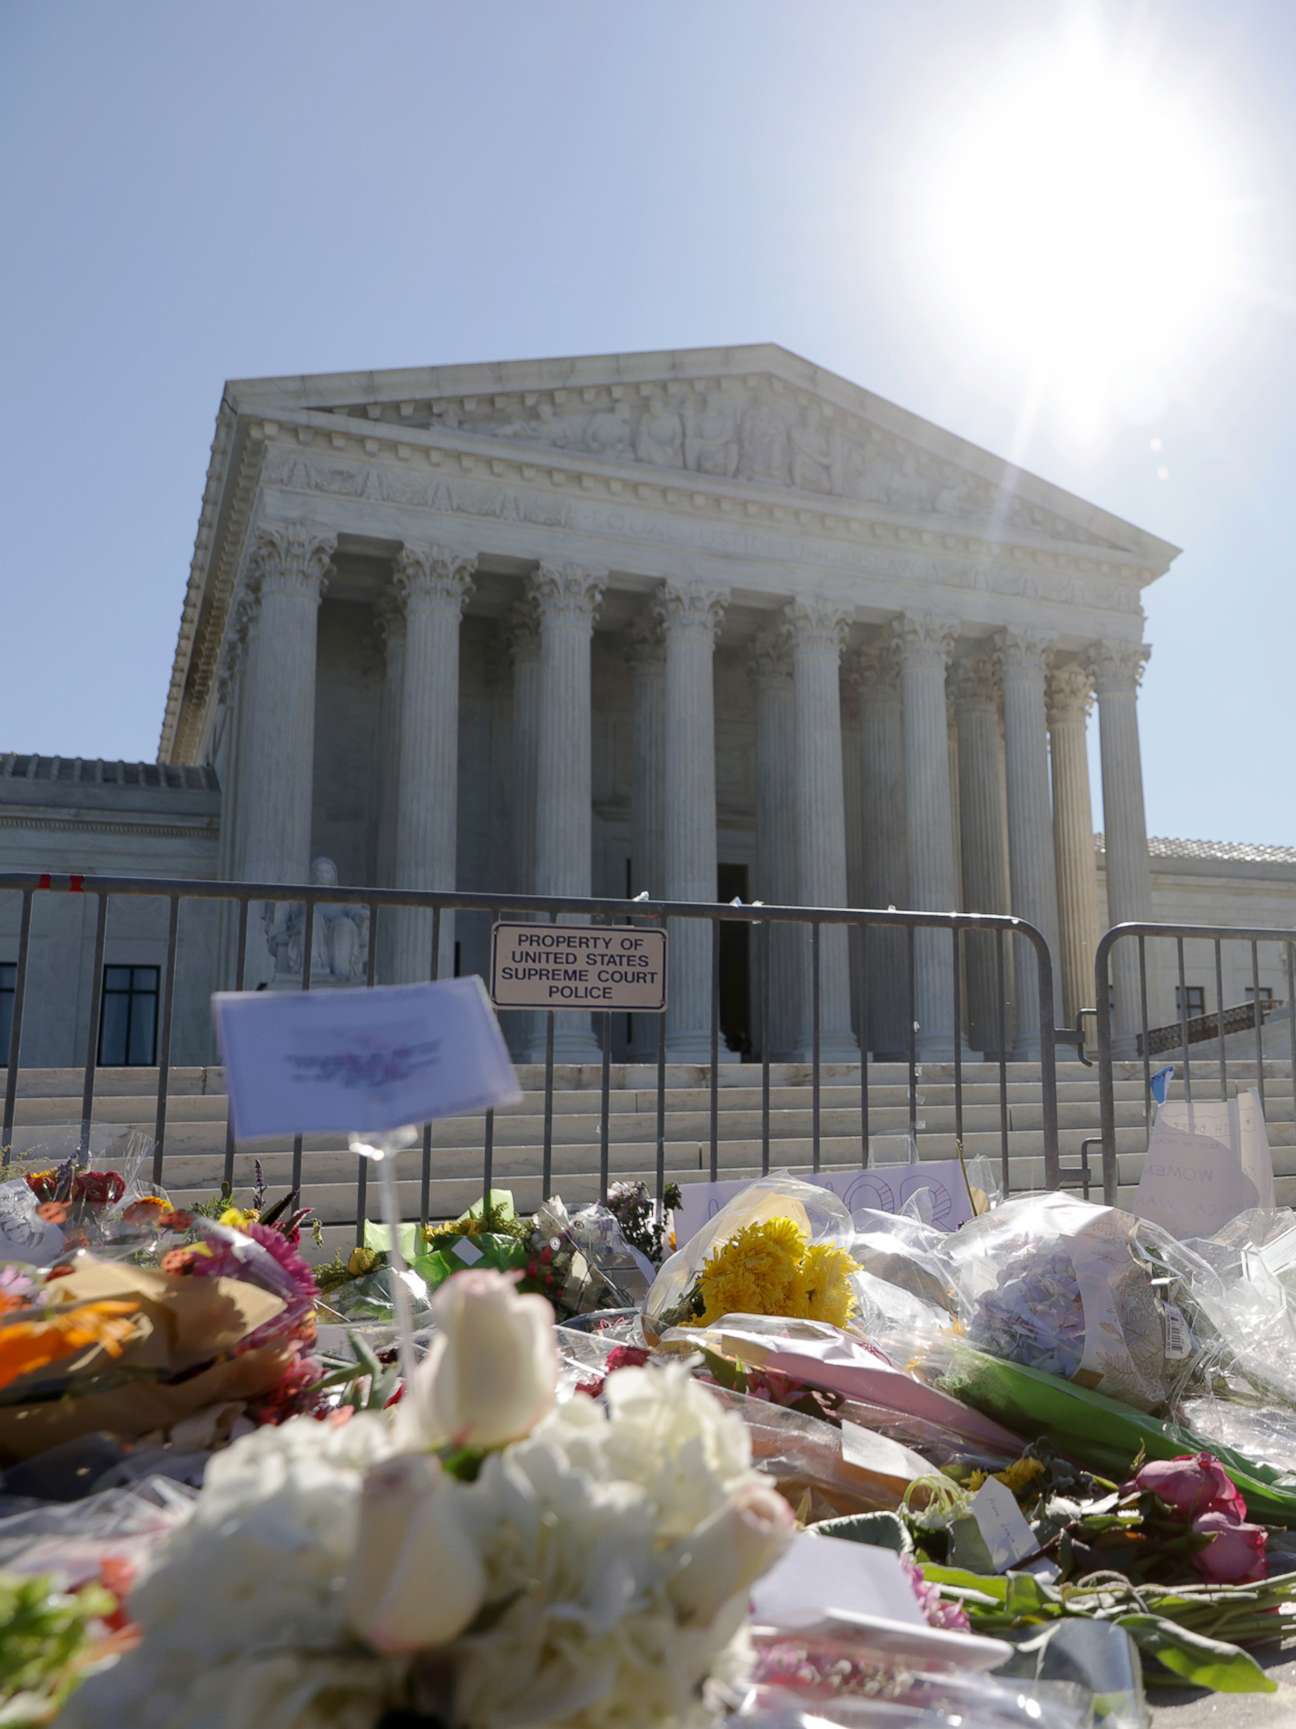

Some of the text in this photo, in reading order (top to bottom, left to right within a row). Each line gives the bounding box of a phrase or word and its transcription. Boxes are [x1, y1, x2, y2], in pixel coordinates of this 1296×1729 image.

[518, 933, 644, 951] PROPERTY OF
[511, 950, 649, 968] UNITED STATES
[501, 966, 658, 984] SUPREME COURT
[548, 985, 614, 1000] POLICE
